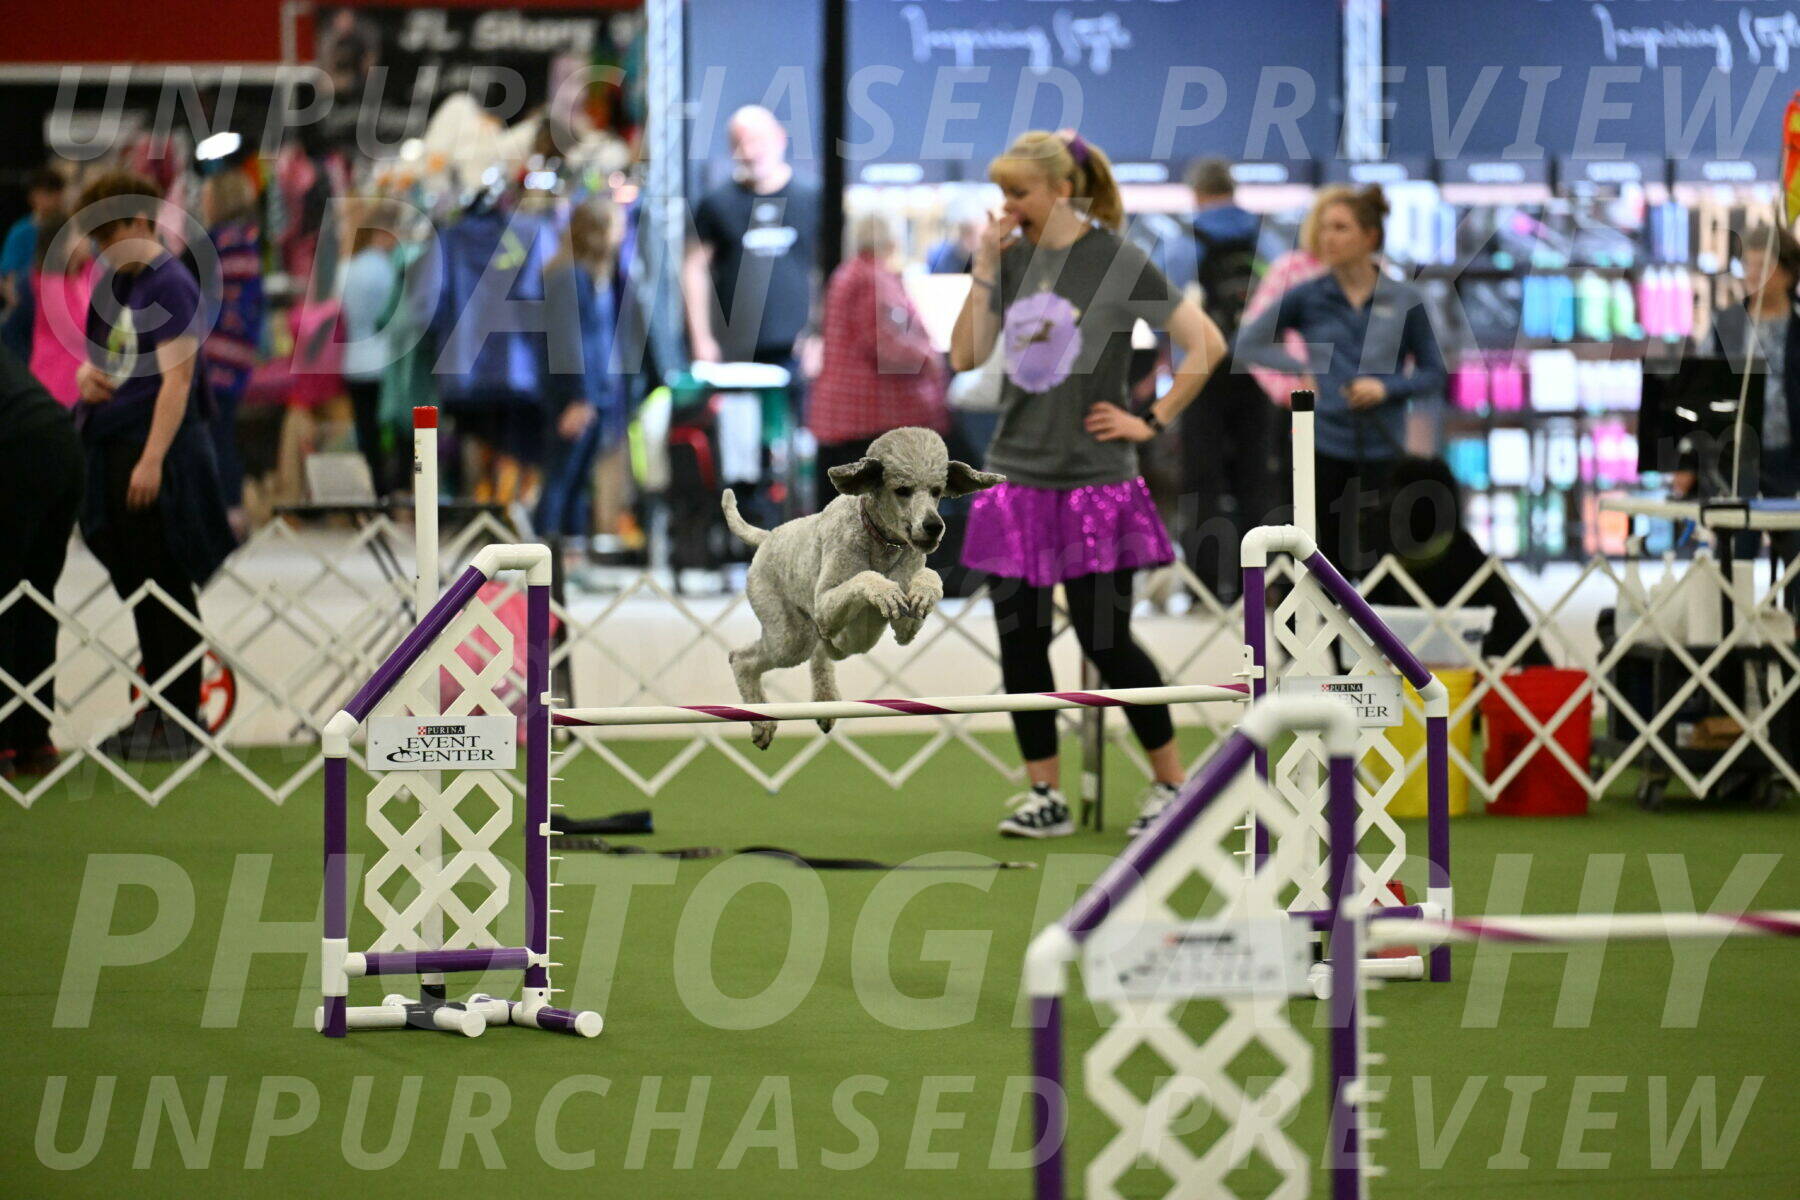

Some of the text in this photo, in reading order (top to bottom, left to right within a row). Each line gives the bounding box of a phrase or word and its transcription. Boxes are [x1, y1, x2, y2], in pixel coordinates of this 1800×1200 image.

[1329, 684, 1362, 692] PURINA
[426, 726, 465, 735] PURINA
[406, 735, 481, 749] EVENT
[386, 749, 495, 763] CENTER
